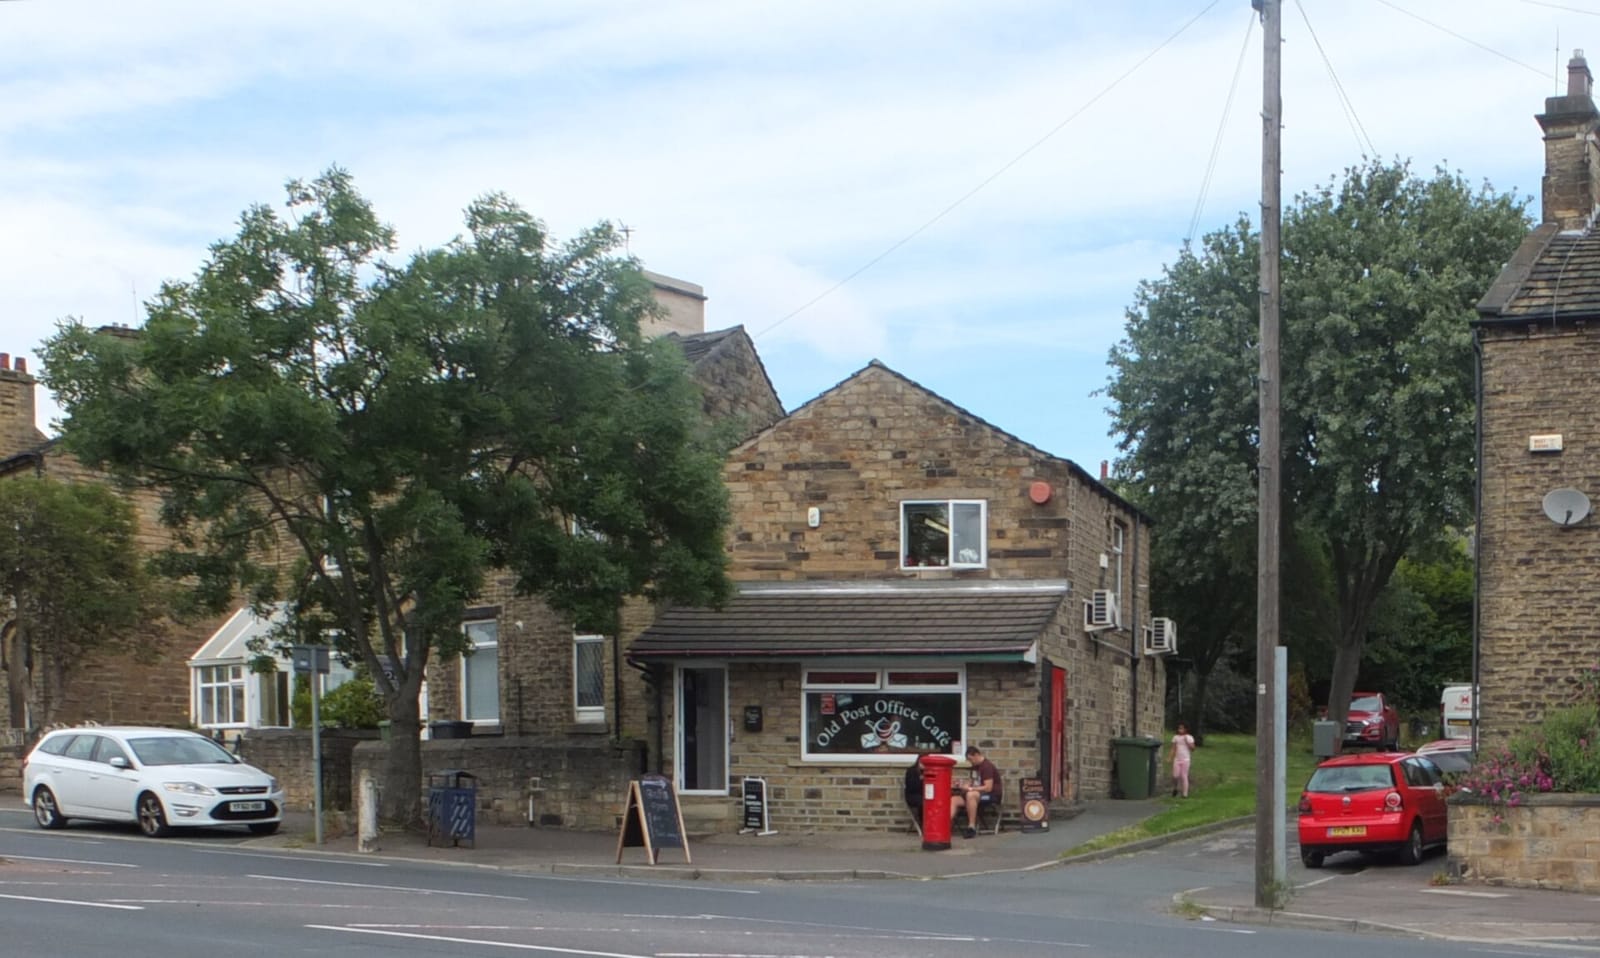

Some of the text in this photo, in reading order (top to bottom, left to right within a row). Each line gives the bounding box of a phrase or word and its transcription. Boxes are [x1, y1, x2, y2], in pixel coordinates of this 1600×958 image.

[817, 699, 952, 747] Old Post Office Café
